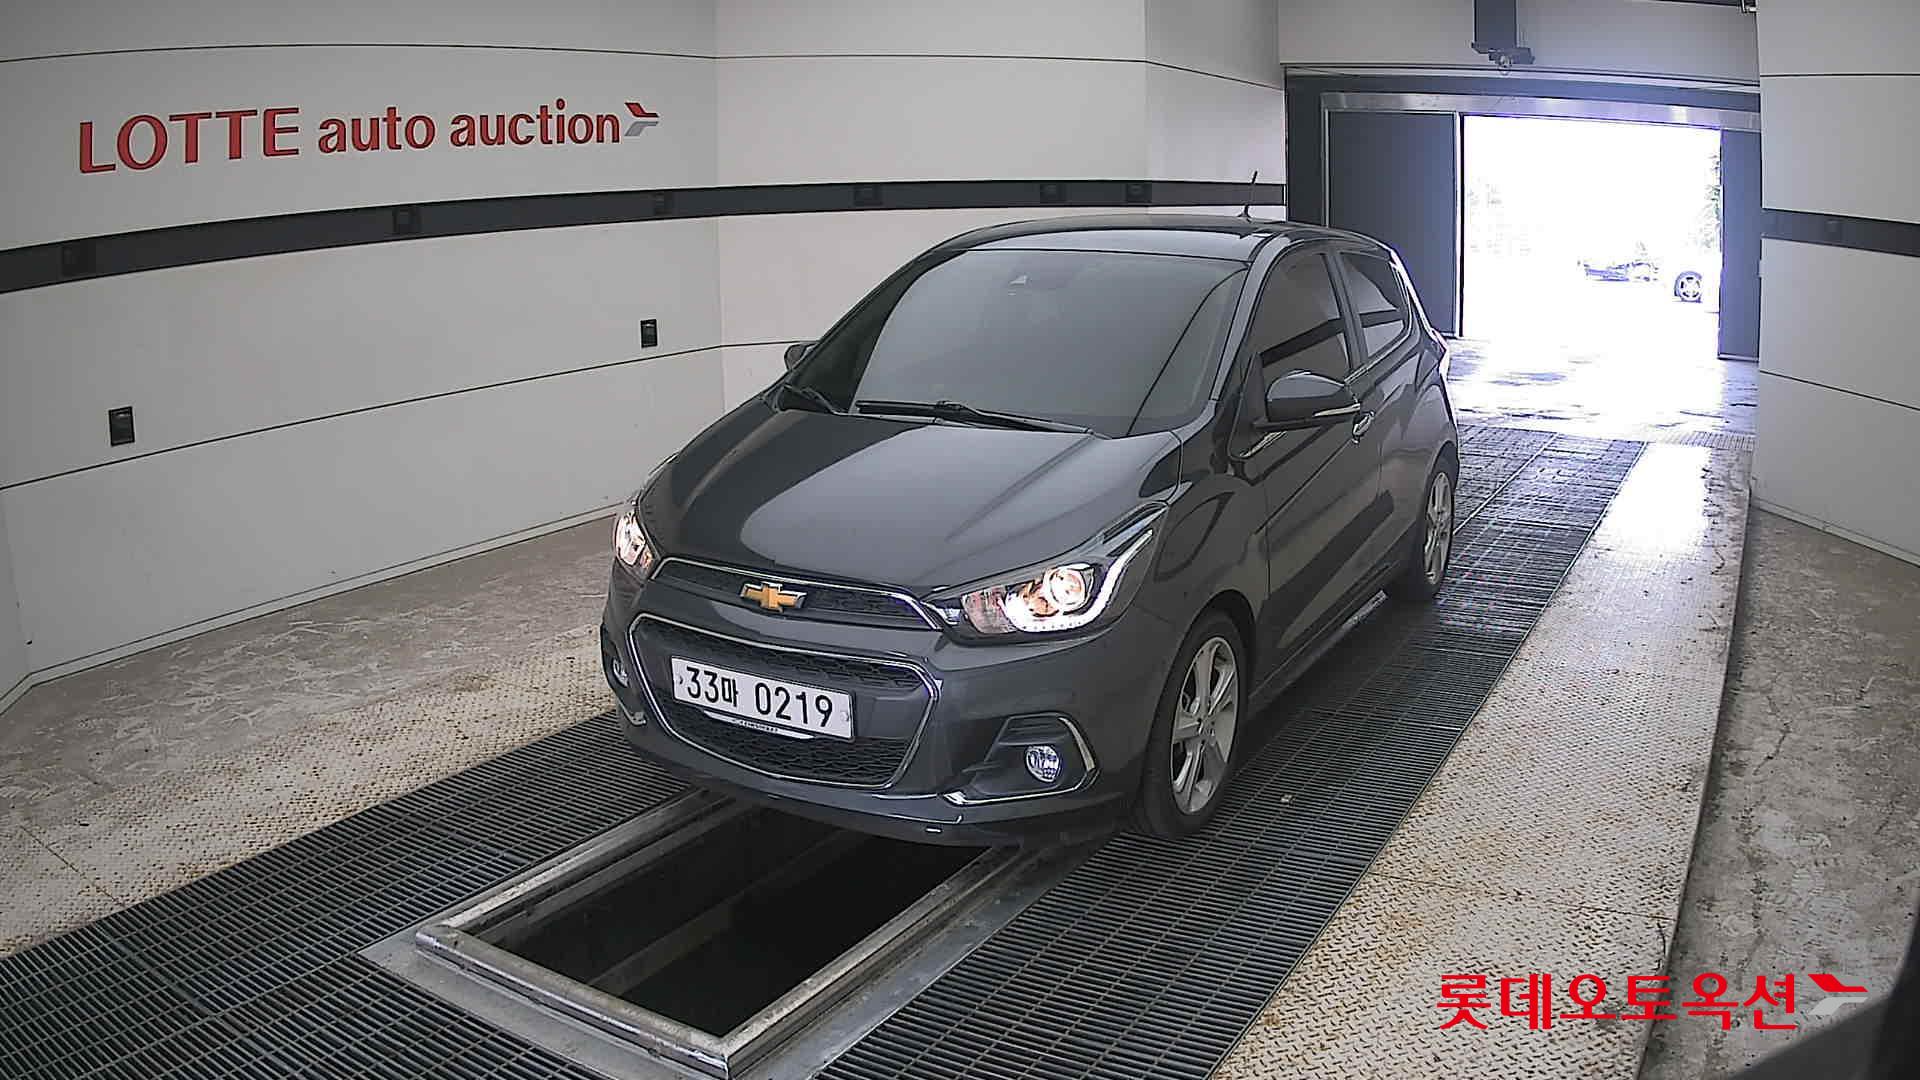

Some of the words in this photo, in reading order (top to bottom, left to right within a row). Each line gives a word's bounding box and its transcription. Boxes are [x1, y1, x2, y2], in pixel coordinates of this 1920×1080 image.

[79, 106, 299, 173] LOTTE
[318, 106, 437, 153] auto
[450, 98, 620, 147] auction
[686, 666, 739, 708] 33마
[754, 682, 833, 727] 0219
